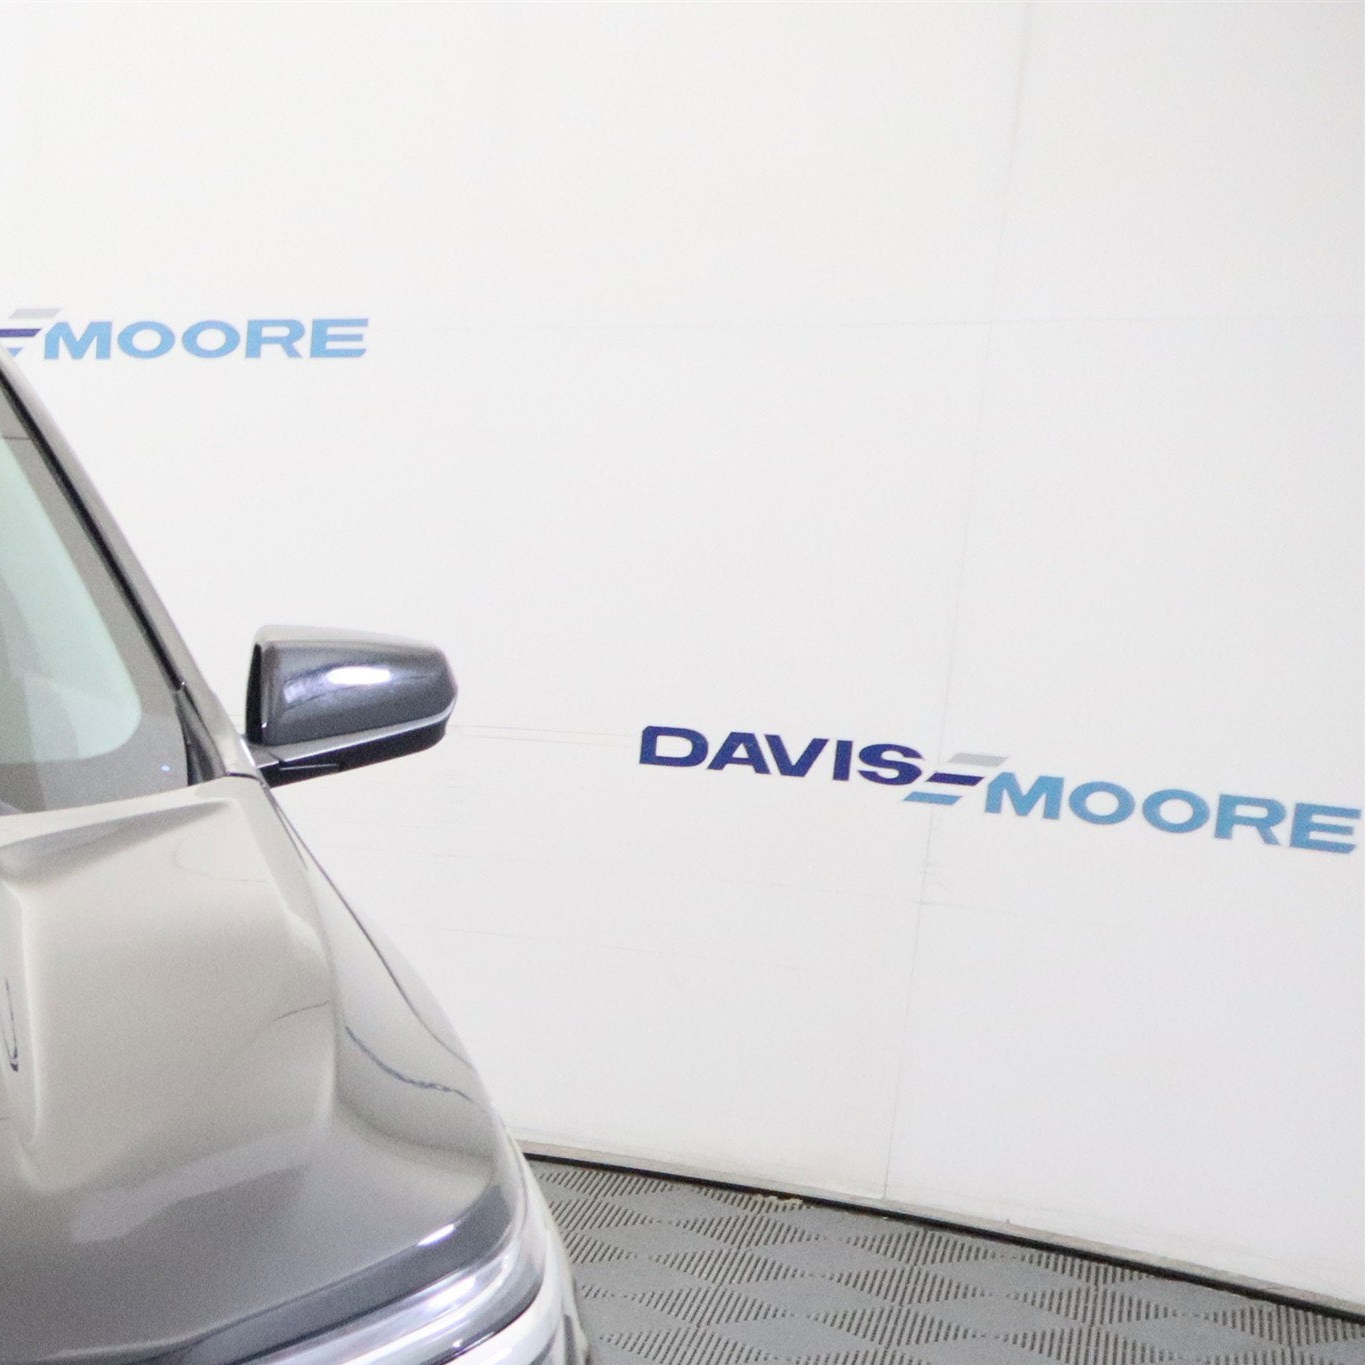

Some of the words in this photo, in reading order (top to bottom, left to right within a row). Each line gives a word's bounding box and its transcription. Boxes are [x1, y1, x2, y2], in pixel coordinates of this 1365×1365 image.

[43, 317, 370, 360] MOORE
[638, 725, 924, 787] DAVIS
[983, 771, 1364, 855] MOORE
